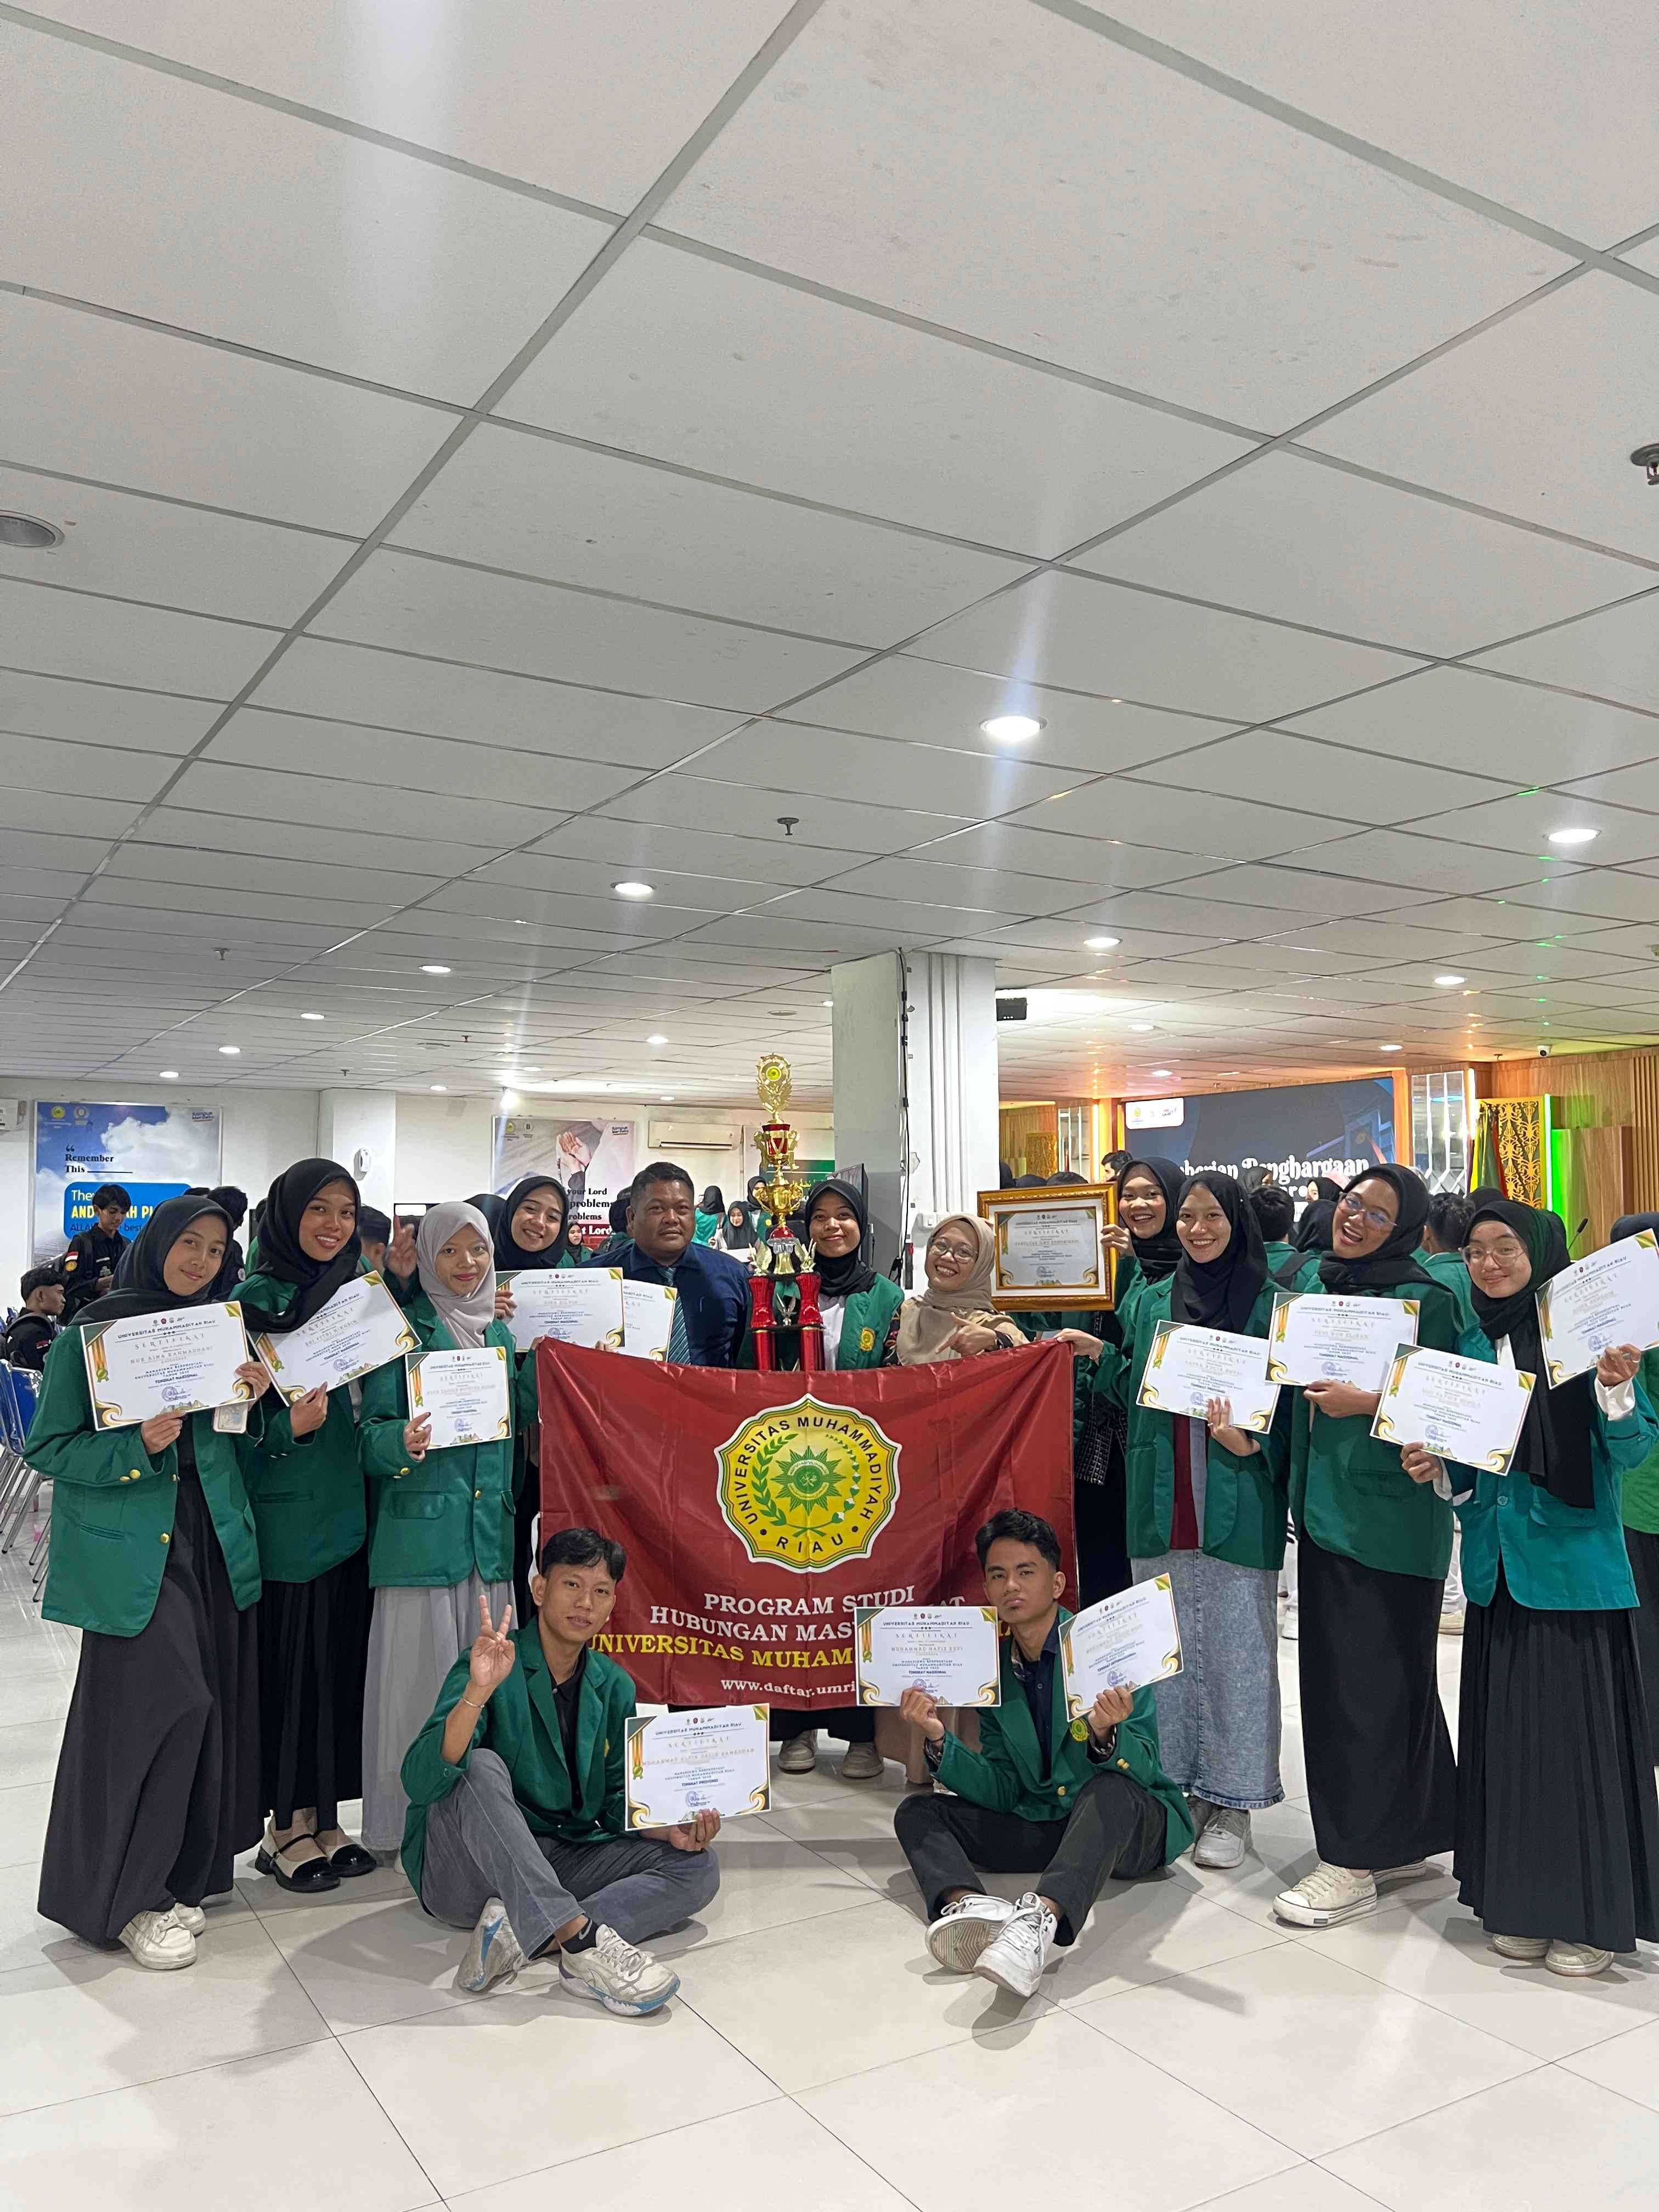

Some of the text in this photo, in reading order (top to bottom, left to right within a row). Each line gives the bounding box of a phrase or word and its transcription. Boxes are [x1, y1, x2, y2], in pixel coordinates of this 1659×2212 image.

[65, 1154, 114, 1163] Remember
[65, 1165, 85, 1173] This
[71, 1190, 94, 1201] The
[71, 1205, 95, 1218] AND
[589, 1226, 612, 1235] Lord
[118, 1329, 155, 1339] UNIVERSITAS
[157, 1322, 202, 1332] MUHAMMADIYAH
[135, 1333, 204, 1349] SERTIFIKAT
[735, 1417, 882, 1525] UNIVERSITAS MUHAMMADIYAH
[776, 1533, 843, 1553] RIAU
[704, 1593, 834, 1616] PROGRAM
[842, 1585, 915, 1613] STUDI
[650, 1605, 787, 1642] HUBUNGAN
